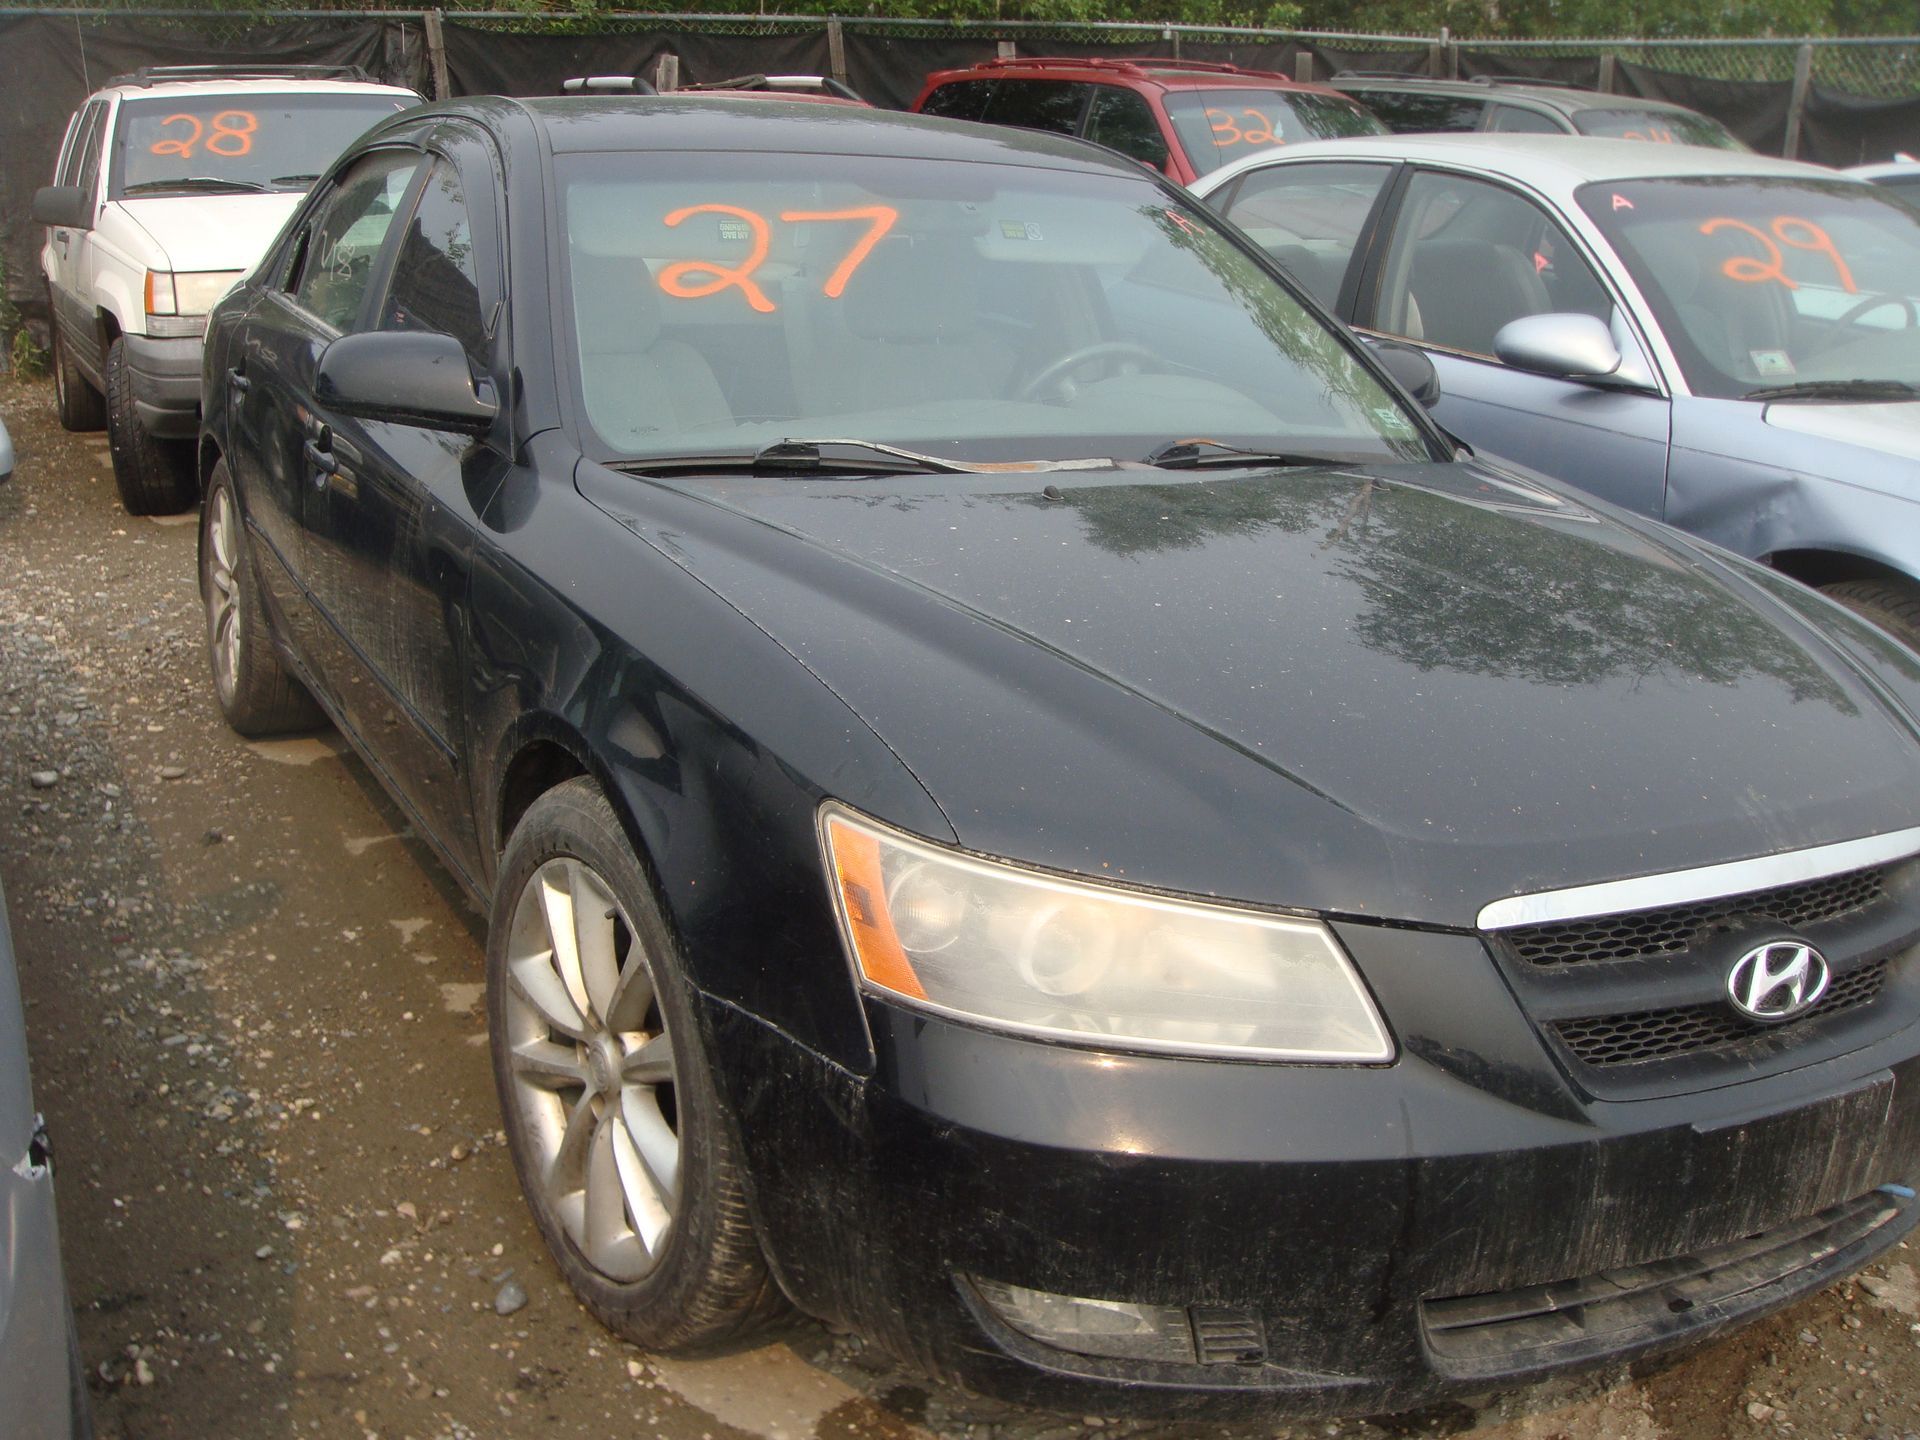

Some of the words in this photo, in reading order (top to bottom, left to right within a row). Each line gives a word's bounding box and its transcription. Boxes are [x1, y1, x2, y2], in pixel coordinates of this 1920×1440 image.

[151, 109, 258, 159] 28
[1203, 108, 1286, 147] 32
[1612, 193, 1635, 211] A
[658, 203, 897, 313] 27
[1699, 215, 1858, 294] 29
